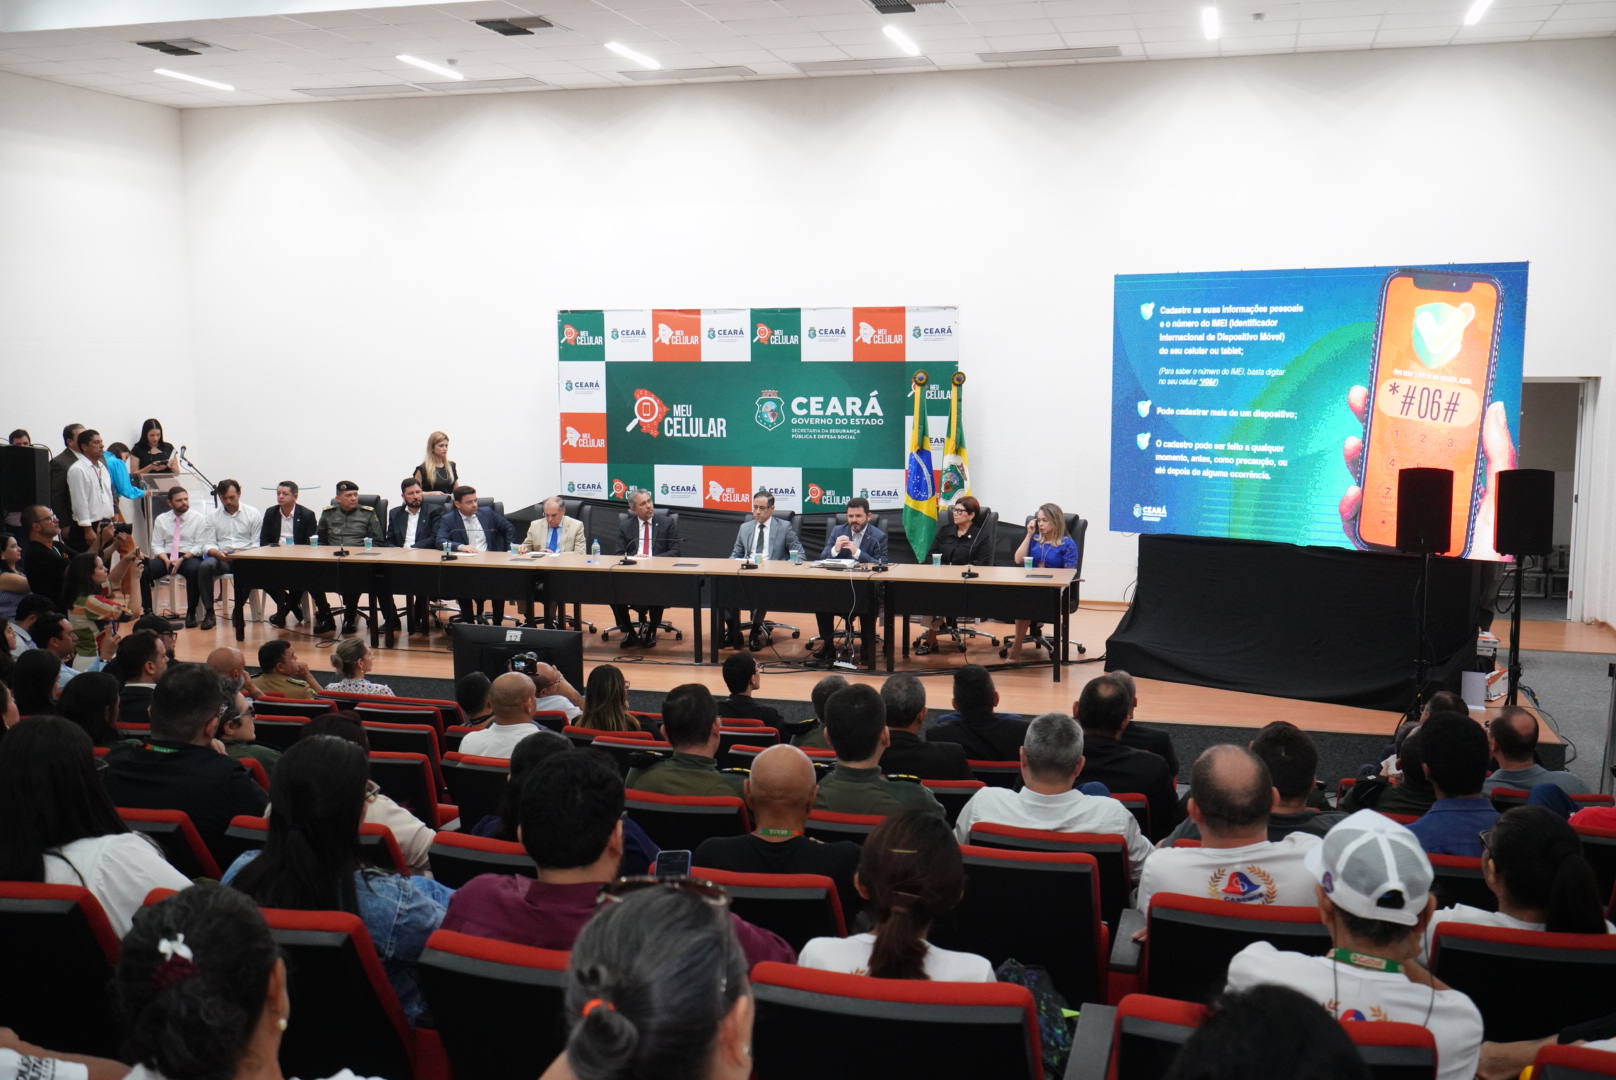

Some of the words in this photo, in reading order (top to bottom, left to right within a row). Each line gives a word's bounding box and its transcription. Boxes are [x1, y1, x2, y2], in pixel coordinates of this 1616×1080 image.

[1160, 306, 1192, 314] Cadastre
[1222, 305, 1268, 315] informações
[1270, 304, 1303, 314] pessoais
[1172, 319, 1199, 328] número
[1200, 319, 1210, 327] do
[1212, 319, 1228, 327] IMEI
[924, 326, 952, 334] CEARÁ
[576, 336, 603, 345] CELULAR
[671, 335, 698, 345] CELULAR
[770, 335, 798, 344] CELULAR
[874, 334, 903, 344] CELULAR
[1160, 333, 1205, 341] Internacional
[1217, 333, 1258, 342] Dispositivo
[1260, 332, 1285, 342] Móvel)
[1221, 347, 1244, 356] tablet;
[926, 390, 952, 399] CELULA
[791, 390, 884, 416] CEARÁ
[673, 404, 692, 416] MEU
[1156, 407, 1174, 415] Pode
[1176, 407, 1209, 416] cadastrar
[1210, 408, 1227, 416] mais
[1253, 410, 1297, 420] dispositivo;
[664, 417, 726, 437] CELULAR
[578, 439, 604, 447] CELULAR
[1163, 441, 1193, 449] cadastro
[1195, 442, 1212, 450] pode
[1227, 443, 1243, 451] feito
[1252, 443, 1284, 454] qualquer
[1156, 454, 1189, 463] momento,
[1191, 455, 1212, 464] antes,
[1236, 457, 1276, 467] precaução,
[1155, 466, 1166, 474] até
[1167, 467, 1190, 476] depois
[1202, 468, 1228, 478] alguma
[1230, 470, 1271, 480] ocorrência.
[722, 493, 750, 502] CELULAR
